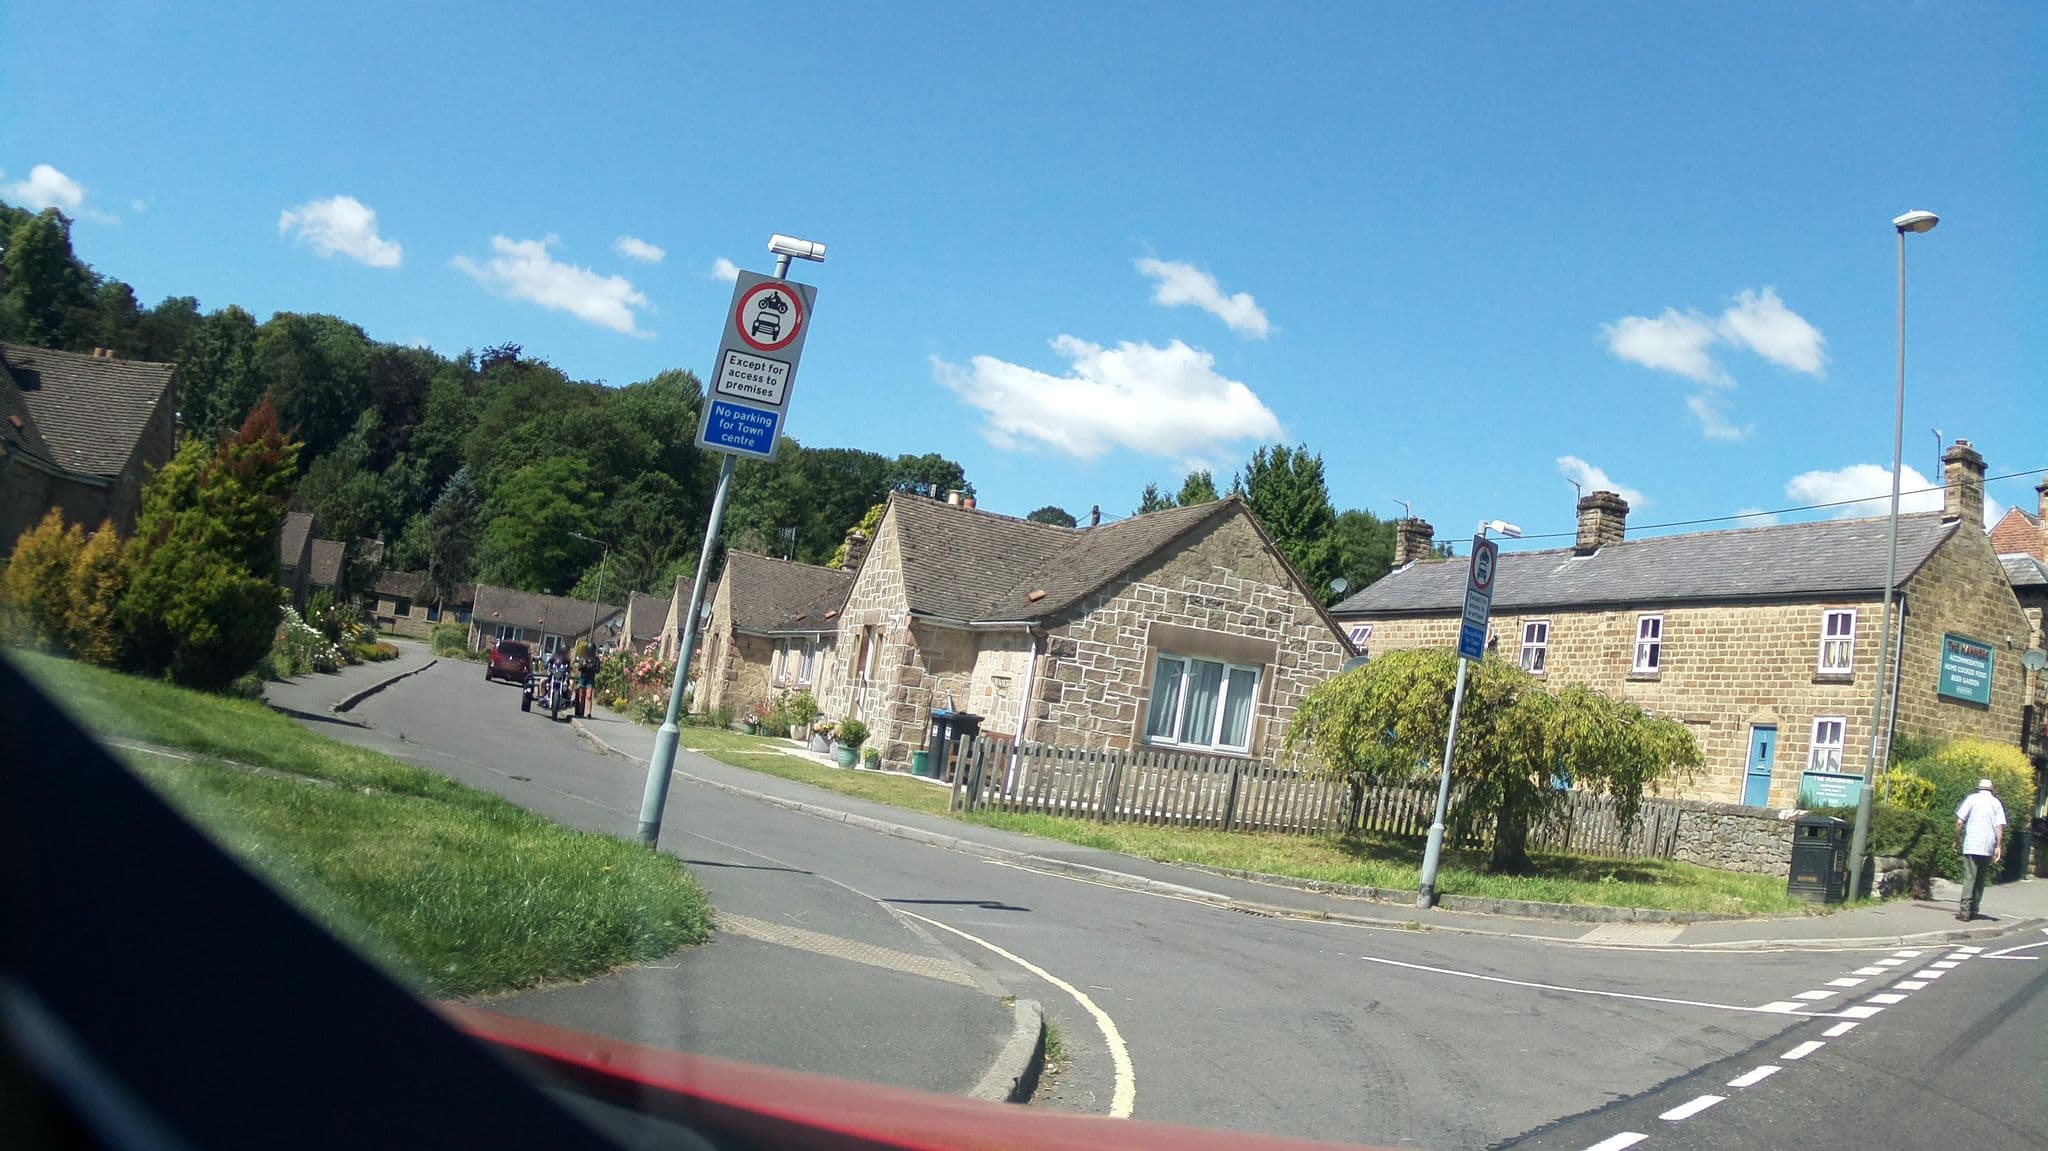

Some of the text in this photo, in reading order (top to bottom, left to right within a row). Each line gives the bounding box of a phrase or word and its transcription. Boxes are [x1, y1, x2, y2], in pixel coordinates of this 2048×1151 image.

[729, 355, 784, 376] Except for
[728, 368, 777, 386] access to
[725, 381, 774, 397] premises
[715, 405, 772, 428] No parking
[719, 418, 764, 436] for Town
[721, 432, 755, 447] centre
[1944, 662, 1988, 679] HOME COOKED FOOD
